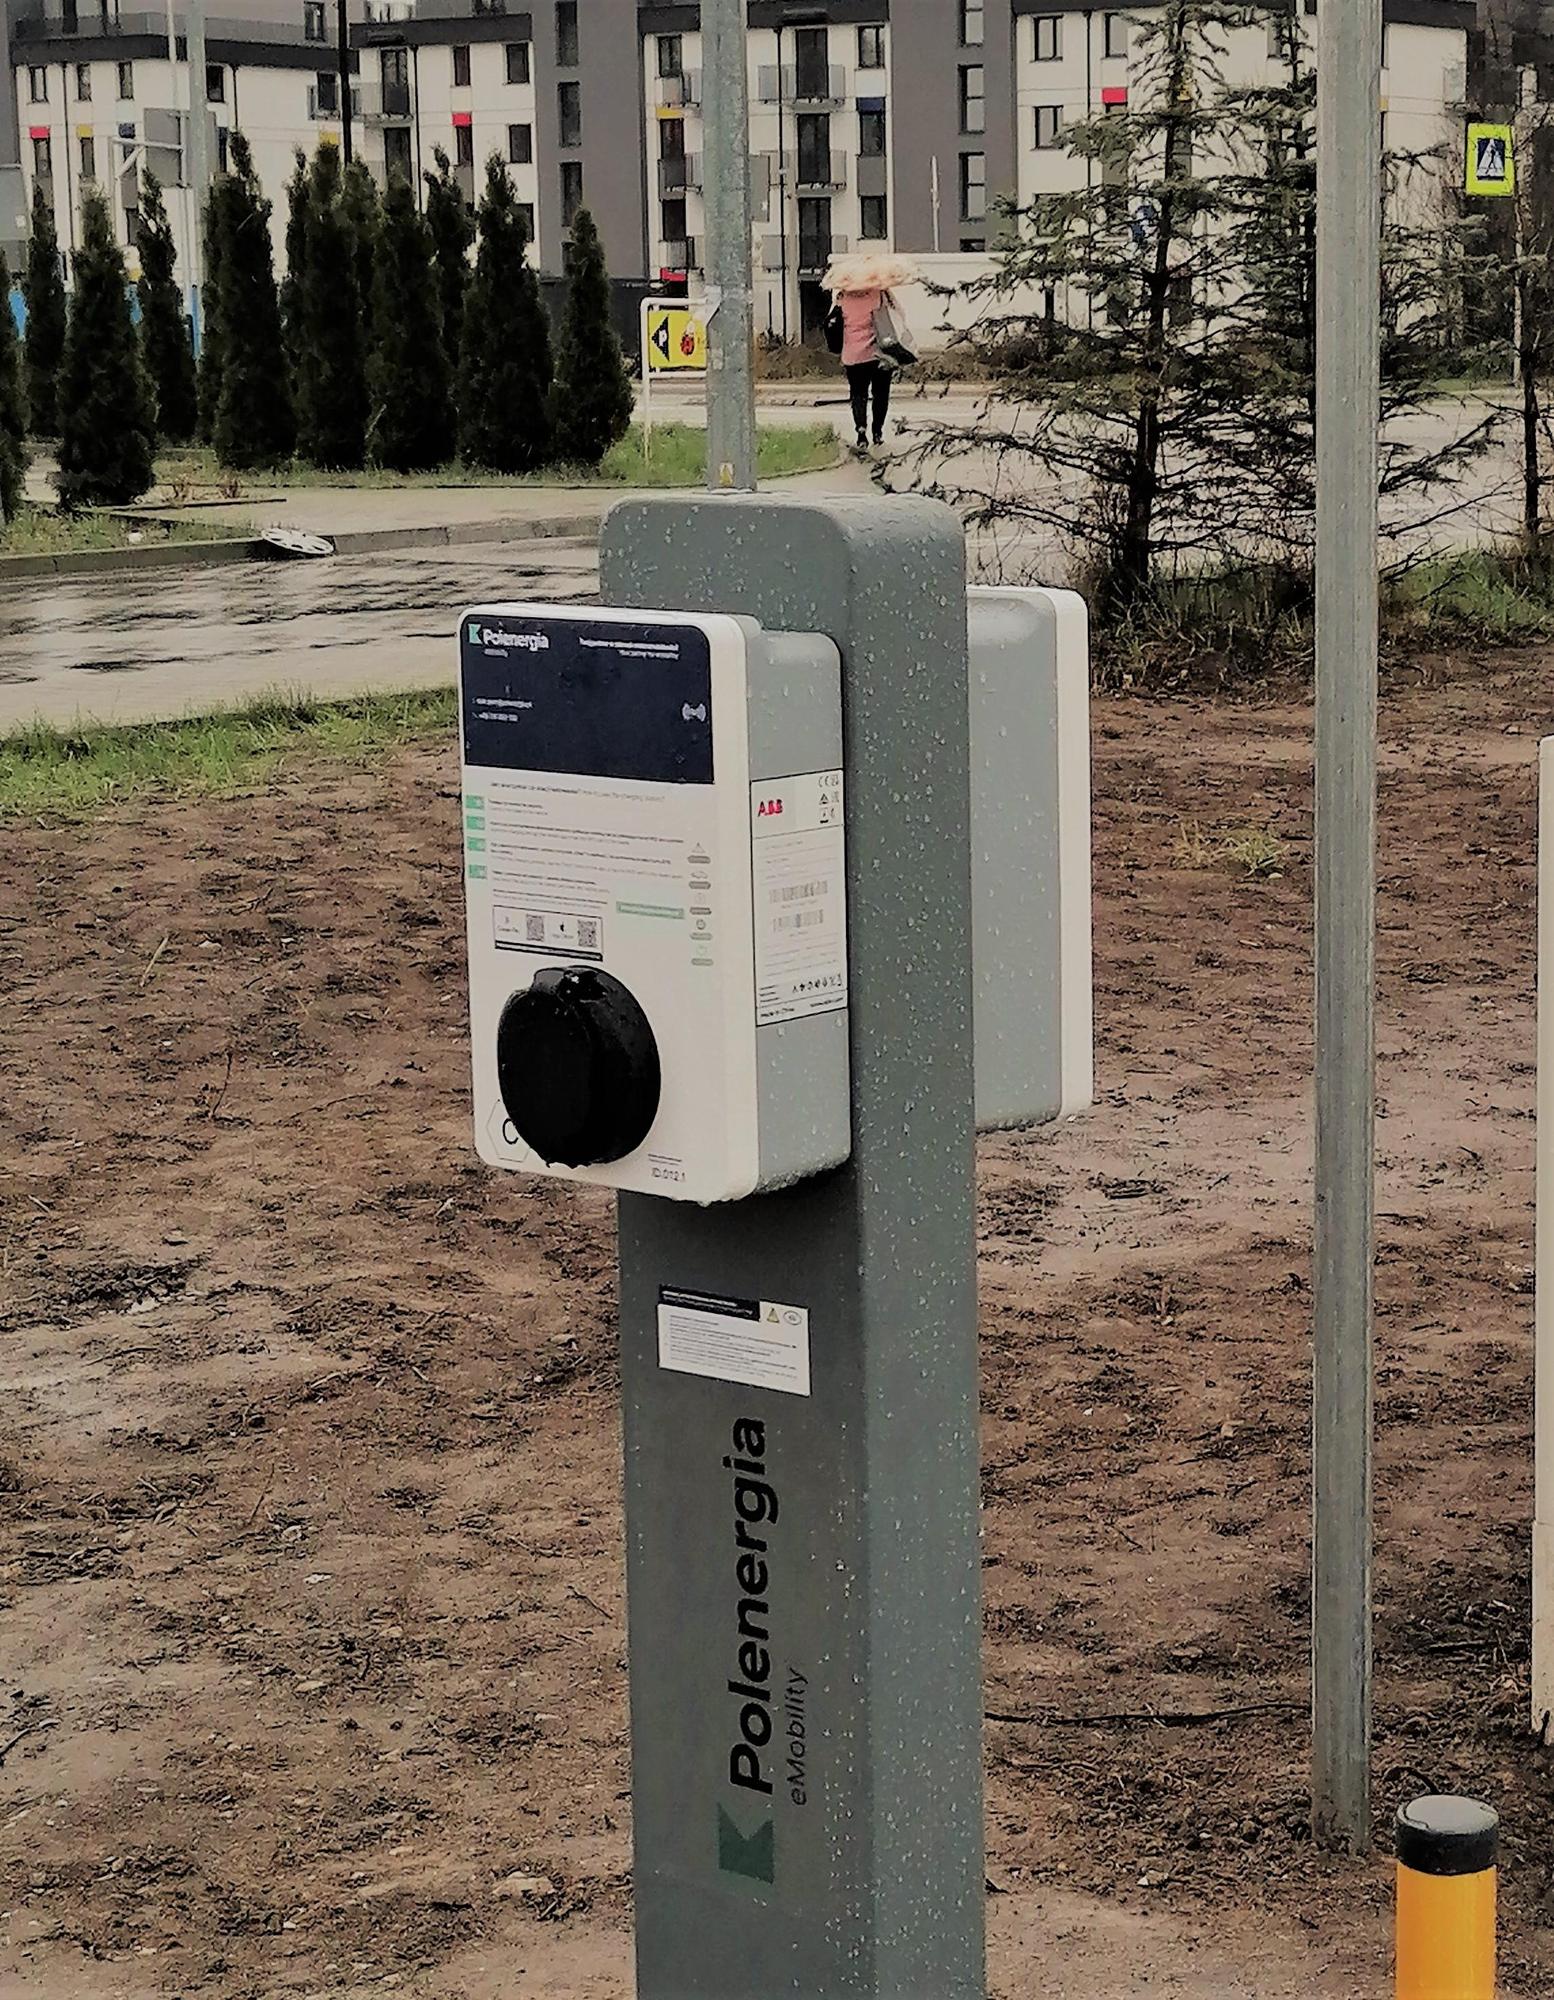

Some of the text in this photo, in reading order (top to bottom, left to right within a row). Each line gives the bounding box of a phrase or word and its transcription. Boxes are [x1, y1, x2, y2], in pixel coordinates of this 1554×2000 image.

[482, 628, 549, 652] Polenergia
[757, 799, 783, 817] ABB
[722, 1417, 779, 1796] Polenergia
[785, 1666, 809, 1806] eMobility
